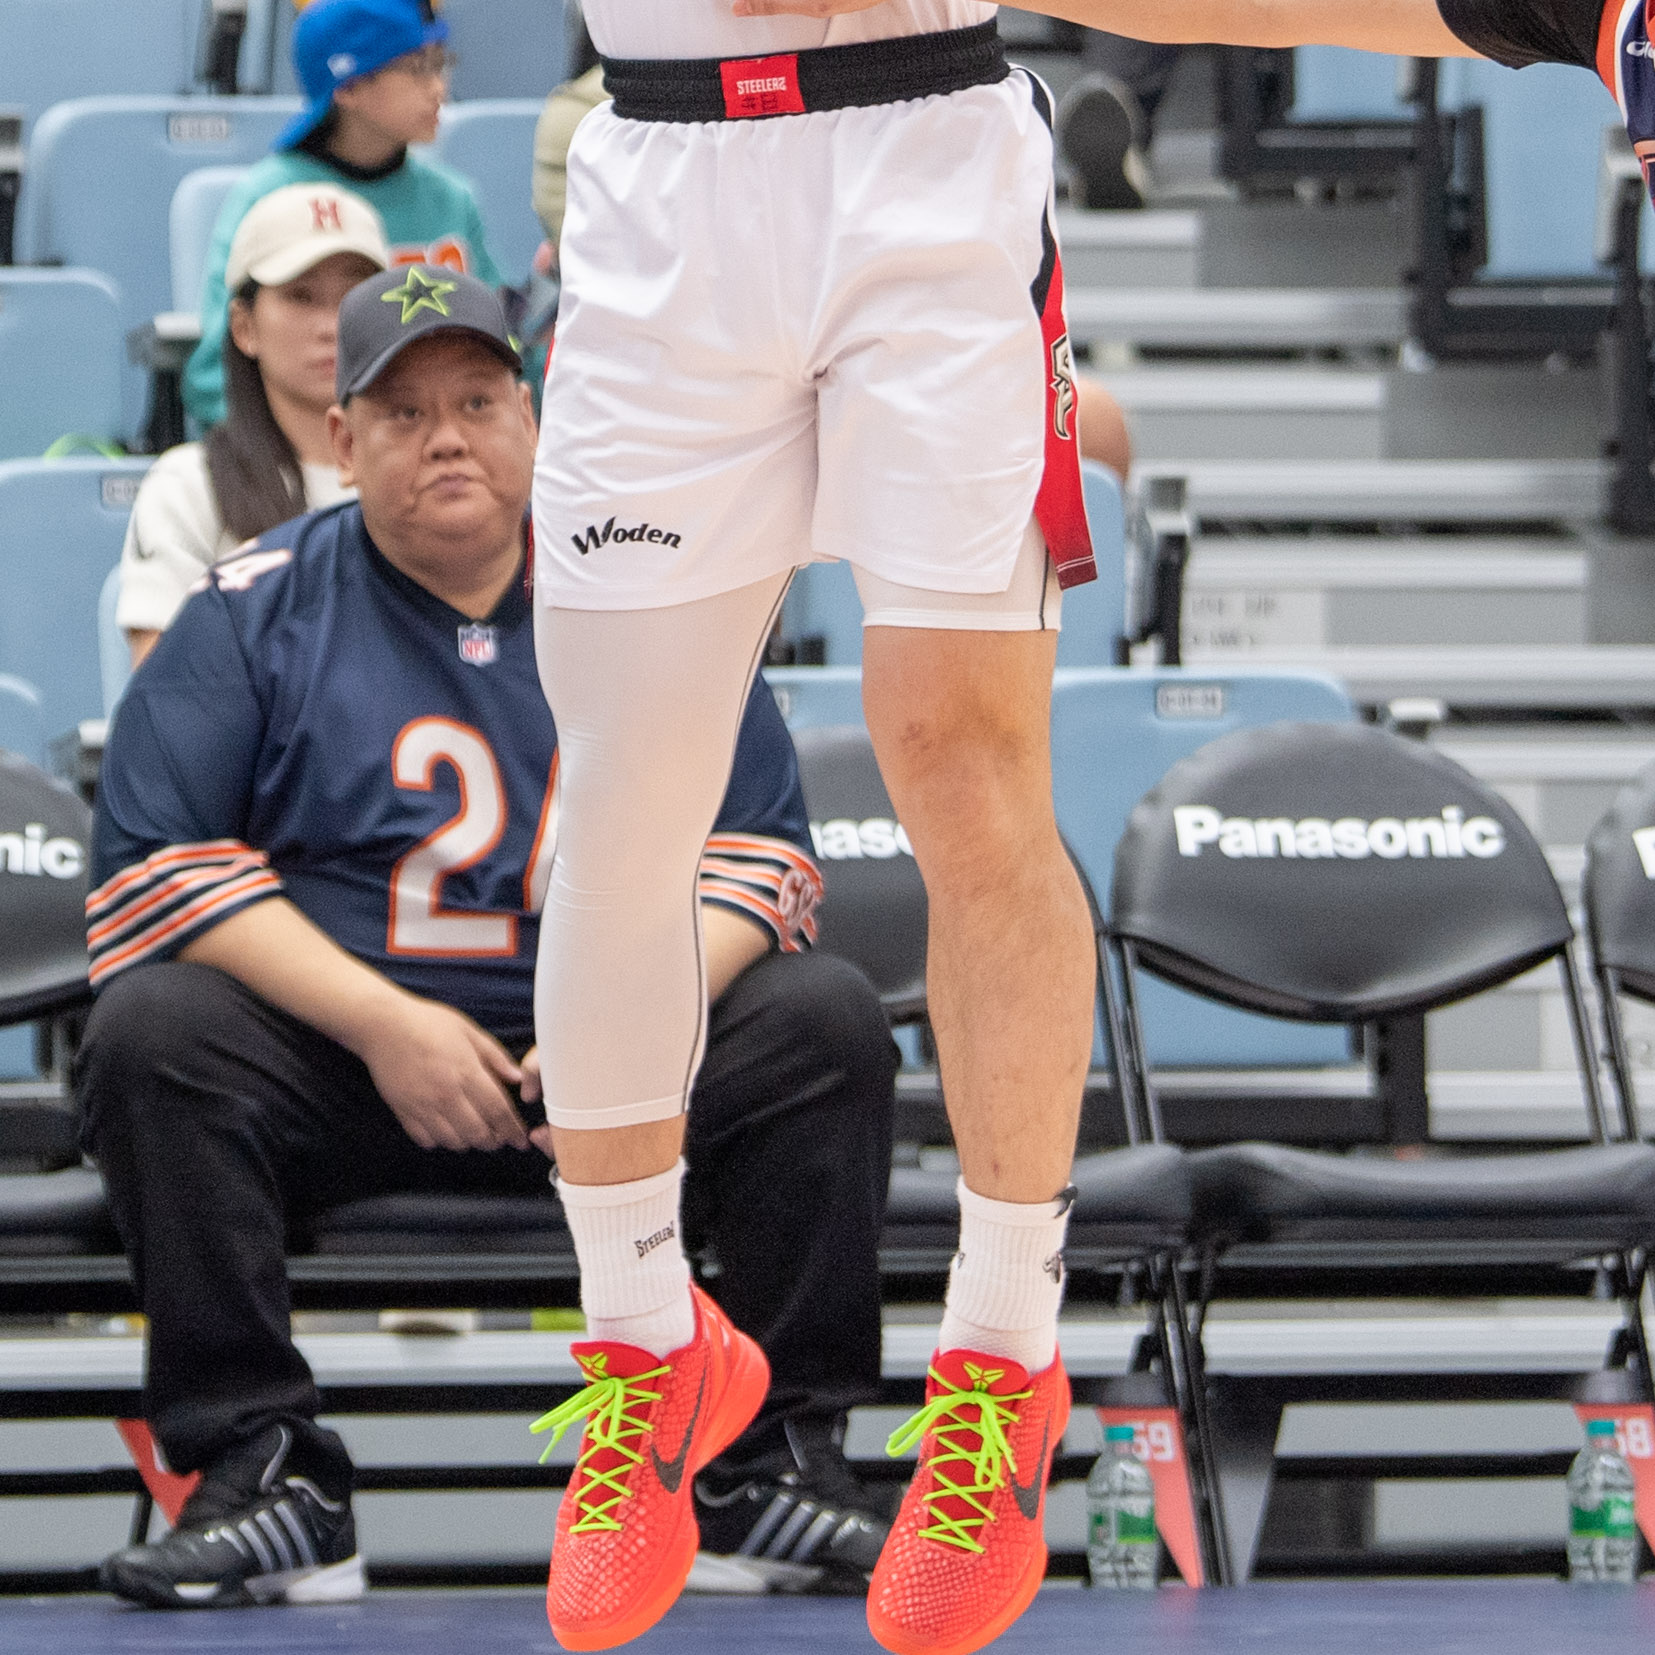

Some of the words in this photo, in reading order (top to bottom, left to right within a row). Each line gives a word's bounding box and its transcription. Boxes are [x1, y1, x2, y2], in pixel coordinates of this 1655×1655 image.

[310, 198, 342, 231] H
[570, 516, 682, 556] Woden
[386, 713, 560, 957] 2
[1173, 802, 1506, 862] Panasonic
